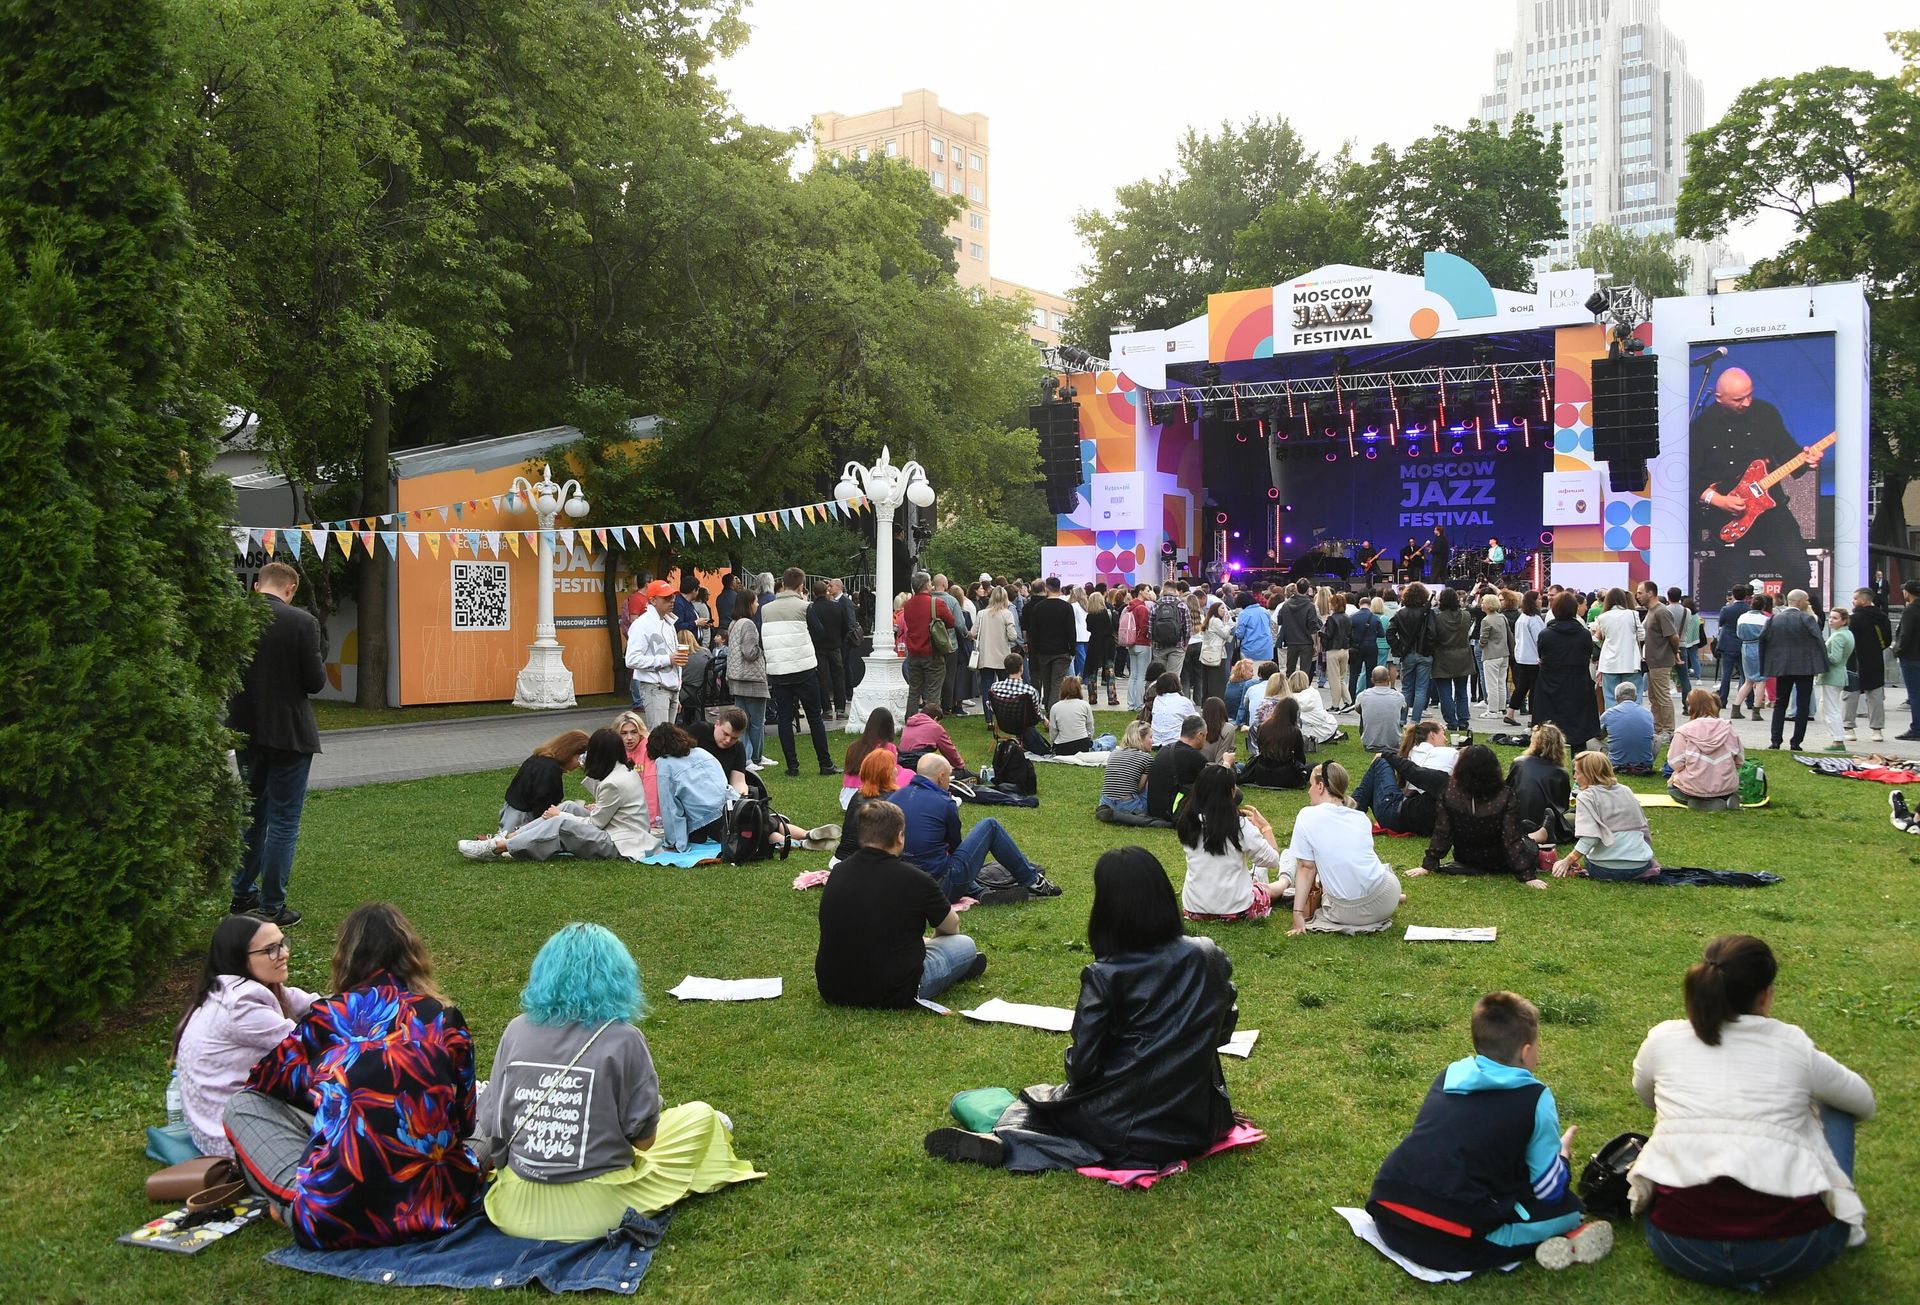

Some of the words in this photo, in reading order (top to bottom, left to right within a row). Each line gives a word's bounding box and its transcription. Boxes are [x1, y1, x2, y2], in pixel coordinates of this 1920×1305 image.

[1293, 285, 1372, 304] MOSCOW
[1292, 299, 1373, 329] JAZZ
[1509, 304, 1535, 313] ФОНД
[1293, 327, 1373, 346] FESTIVAL
[1400, 461, 1496, 479] MOSCOW
[1400, 479, 1496, 508] JAZZ
[1399, 511, 1494, 527] FESTIVAL
[1766, 584, 1781, 594] PR
